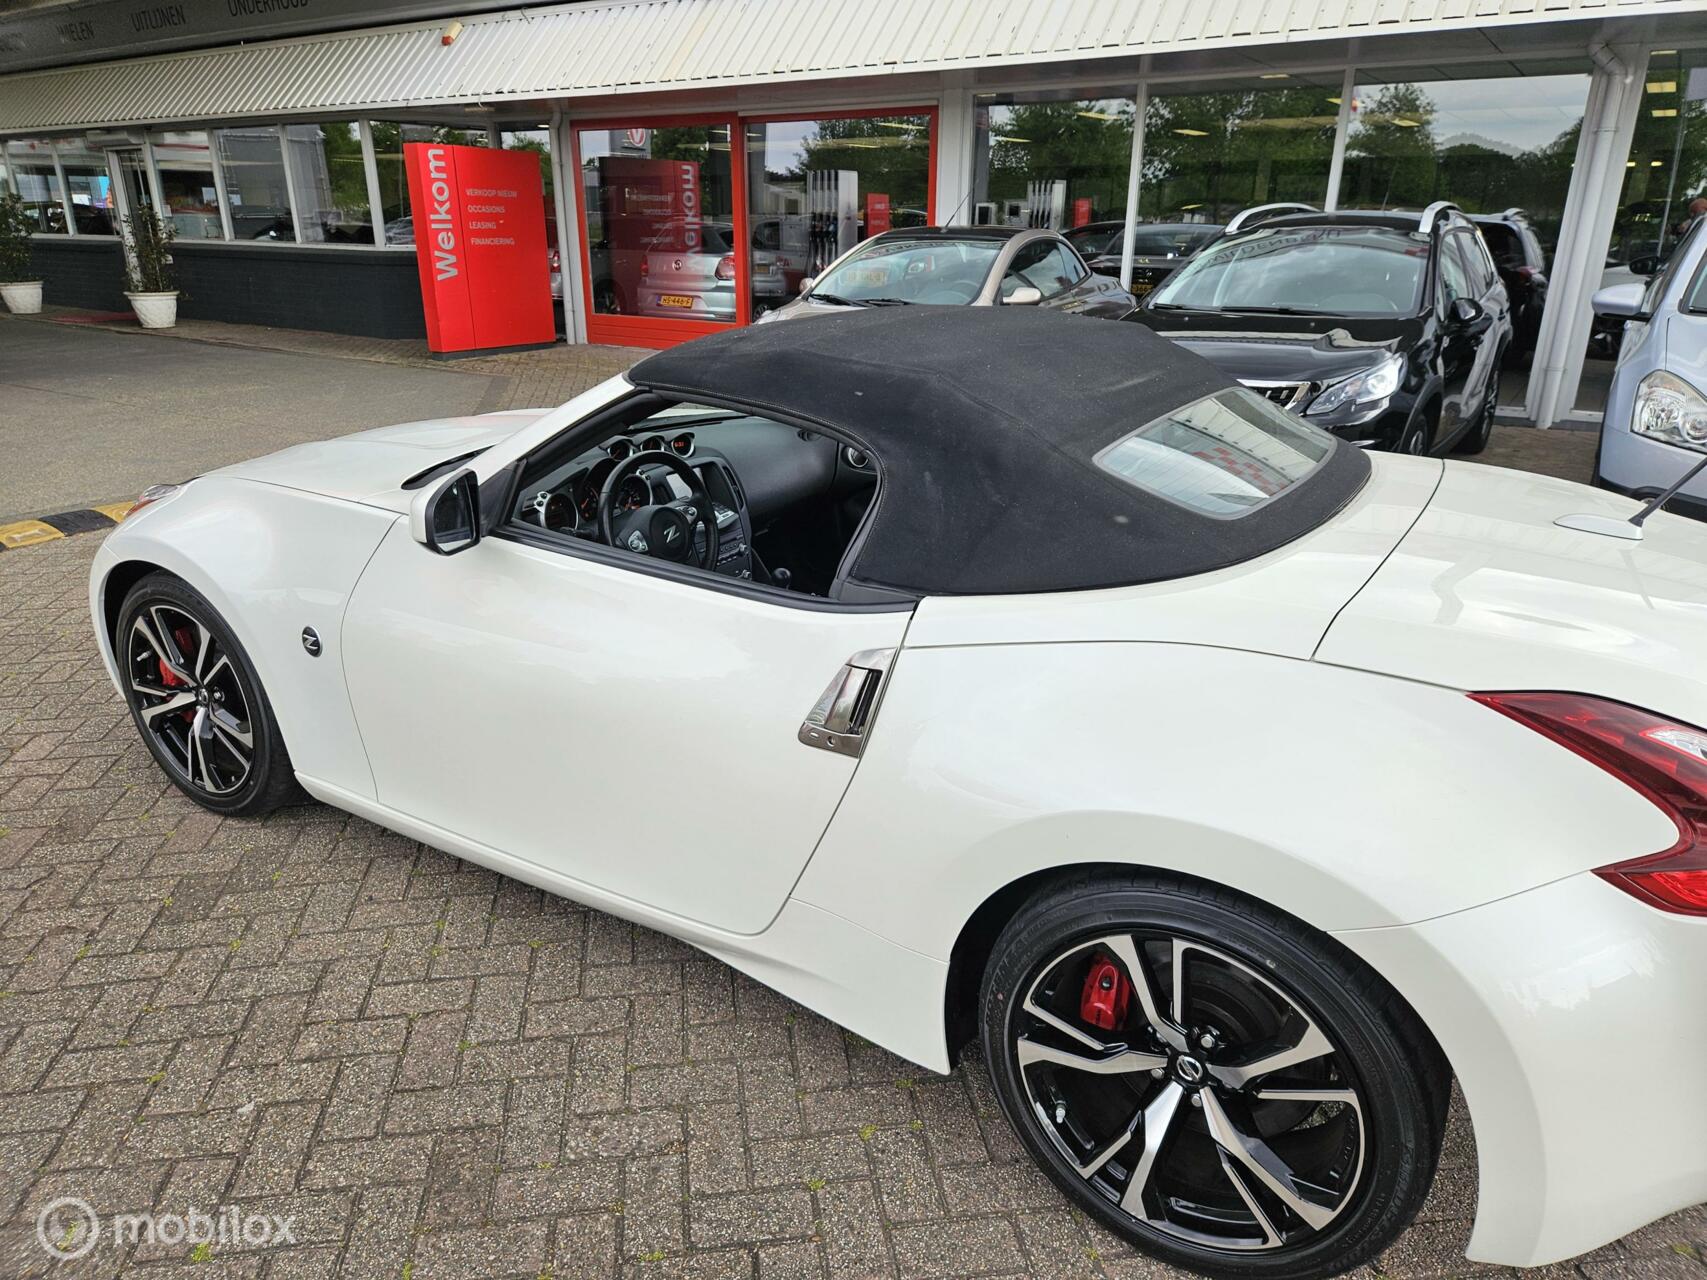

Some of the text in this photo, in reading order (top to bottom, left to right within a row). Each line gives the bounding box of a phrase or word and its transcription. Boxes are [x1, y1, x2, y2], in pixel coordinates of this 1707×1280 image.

[468, 204, 505, 213] OCCASIONS
[428, 148, 458, 281] Welkom
[469, 221, 496, 230] LEASING
